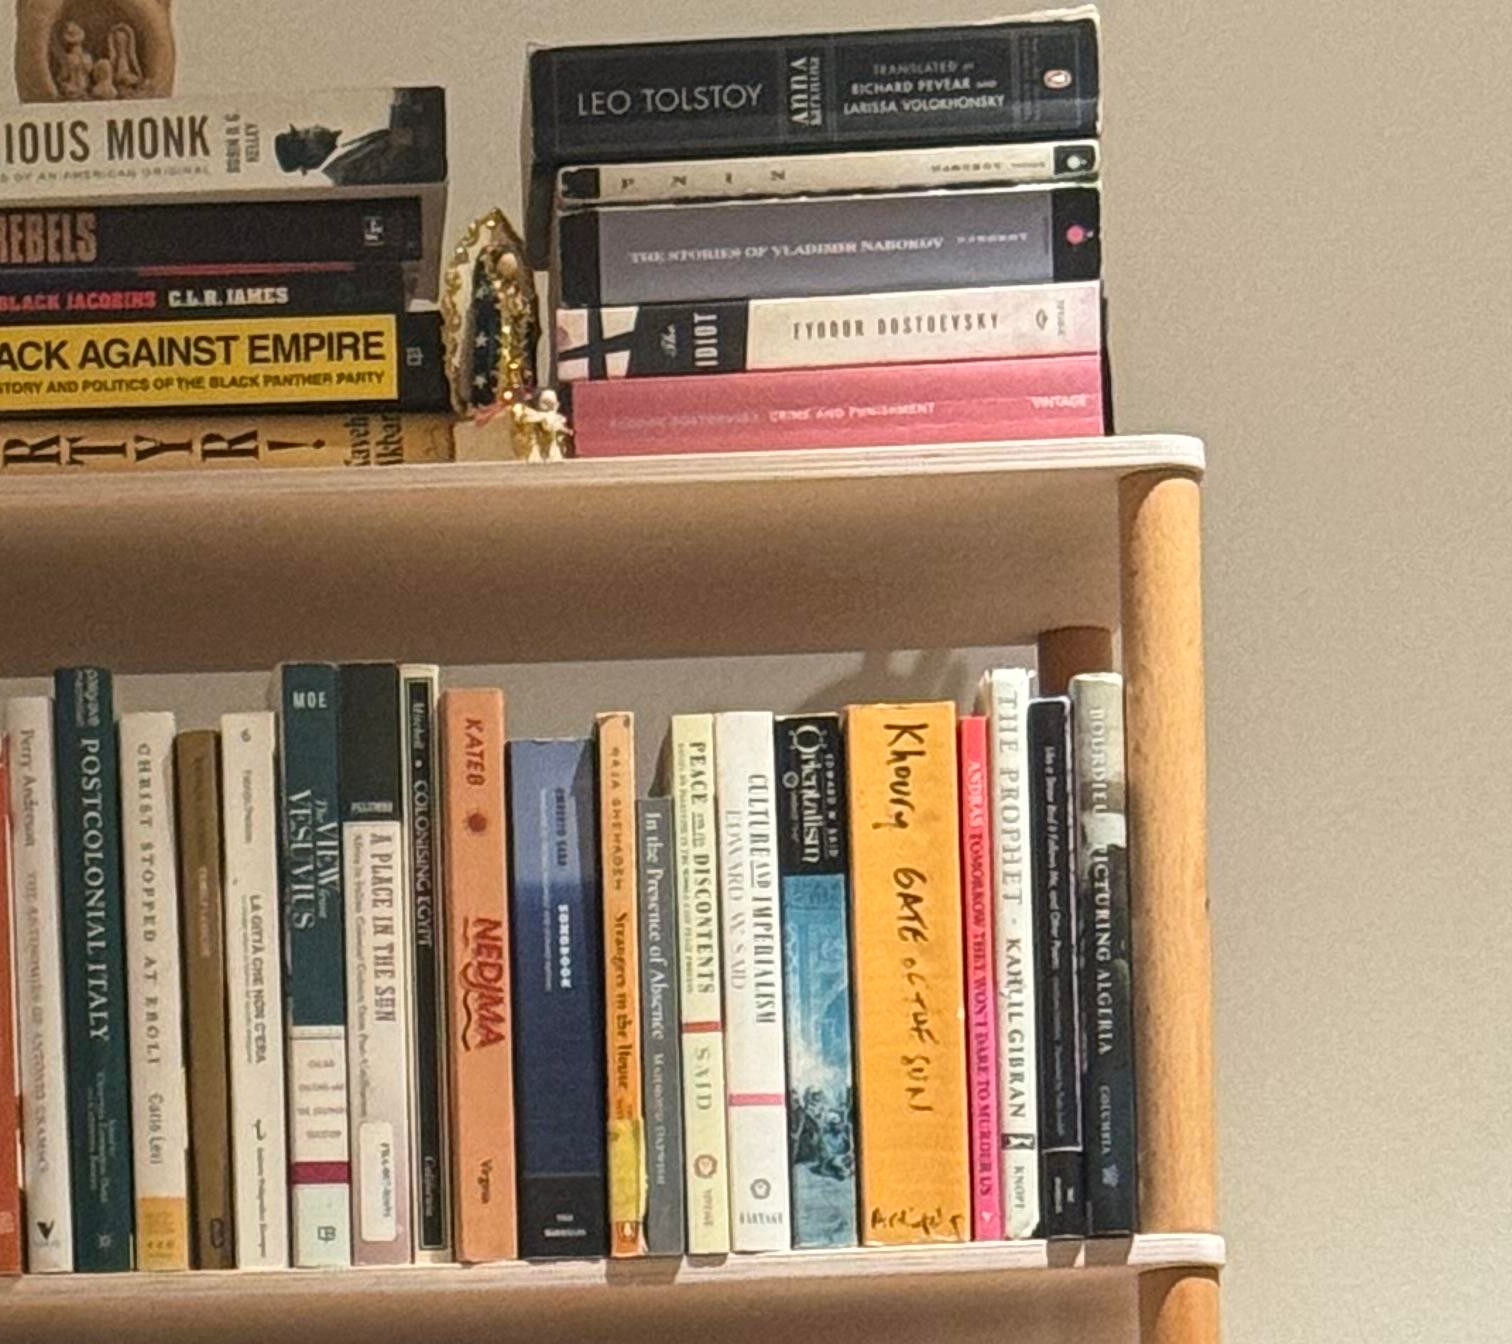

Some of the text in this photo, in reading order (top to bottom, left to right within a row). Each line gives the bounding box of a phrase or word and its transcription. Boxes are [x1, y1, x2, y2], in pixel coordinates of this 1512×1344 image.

[578, 84, 763, 116] LEO TOLSTOY
[107, 115, 211, 161] MONK
[79, 334, 238, 369] AGAINST
[249, 331, 385, 363] EMPIRE
[694, 312, 717, 366] IDIOT
[793, 314, 999, 341] FYODOR DOSTOEVSKY
[292, 690, 327, 709] MOE
[465, 719, 485, 786] KATEB
[875, 724, 928, 942] Khoury GATE
[998, 697, 1022, 905] THE PROPHET
[81, 739, 109, 1041] POSTCOLONIAL ITALY
[288, 790, 314, 929] VESUVIUS
[646, 812, 667, 1039] In the Presence of Absence
[464, 918, 504, 1051] NEDJMA
